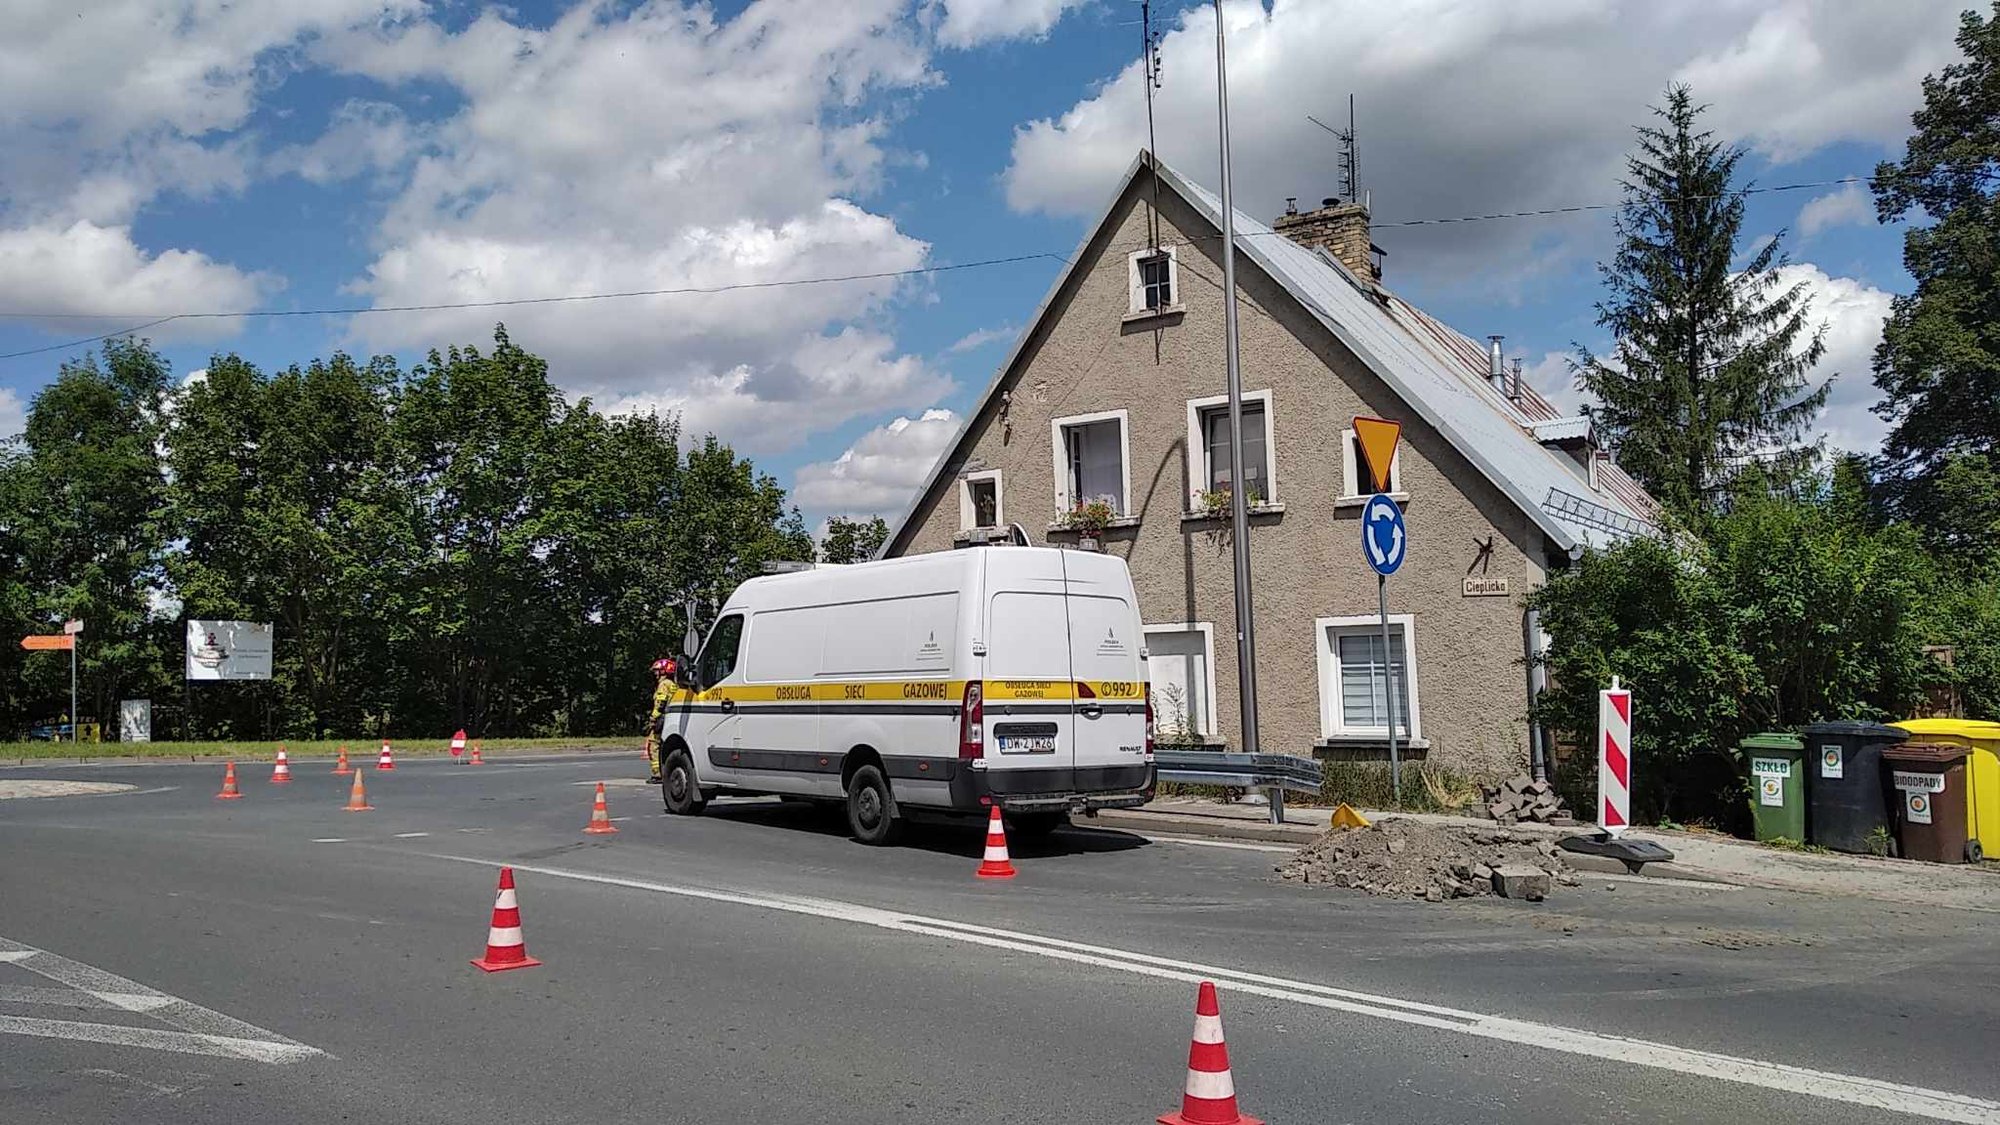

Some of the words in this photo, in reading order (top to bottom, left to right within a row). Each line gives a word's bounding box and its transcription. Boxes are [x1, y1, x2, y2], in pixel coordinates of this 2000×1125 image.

[1036, 680, 1051, 689] SIECI
[1112, 681, 1132, 697] 992
[775, 686, 812, 701] OBSŁUGA
[844, 685, 866, 700] SIECI
[903, 683, 948, 700] GAZOWEJ
[1014, 690, 1044, 700] GAZOWEJ
[1755, 761, 1788, 774] SZKŁO
[1894, 774, 1942, 789] BIOODPADY
